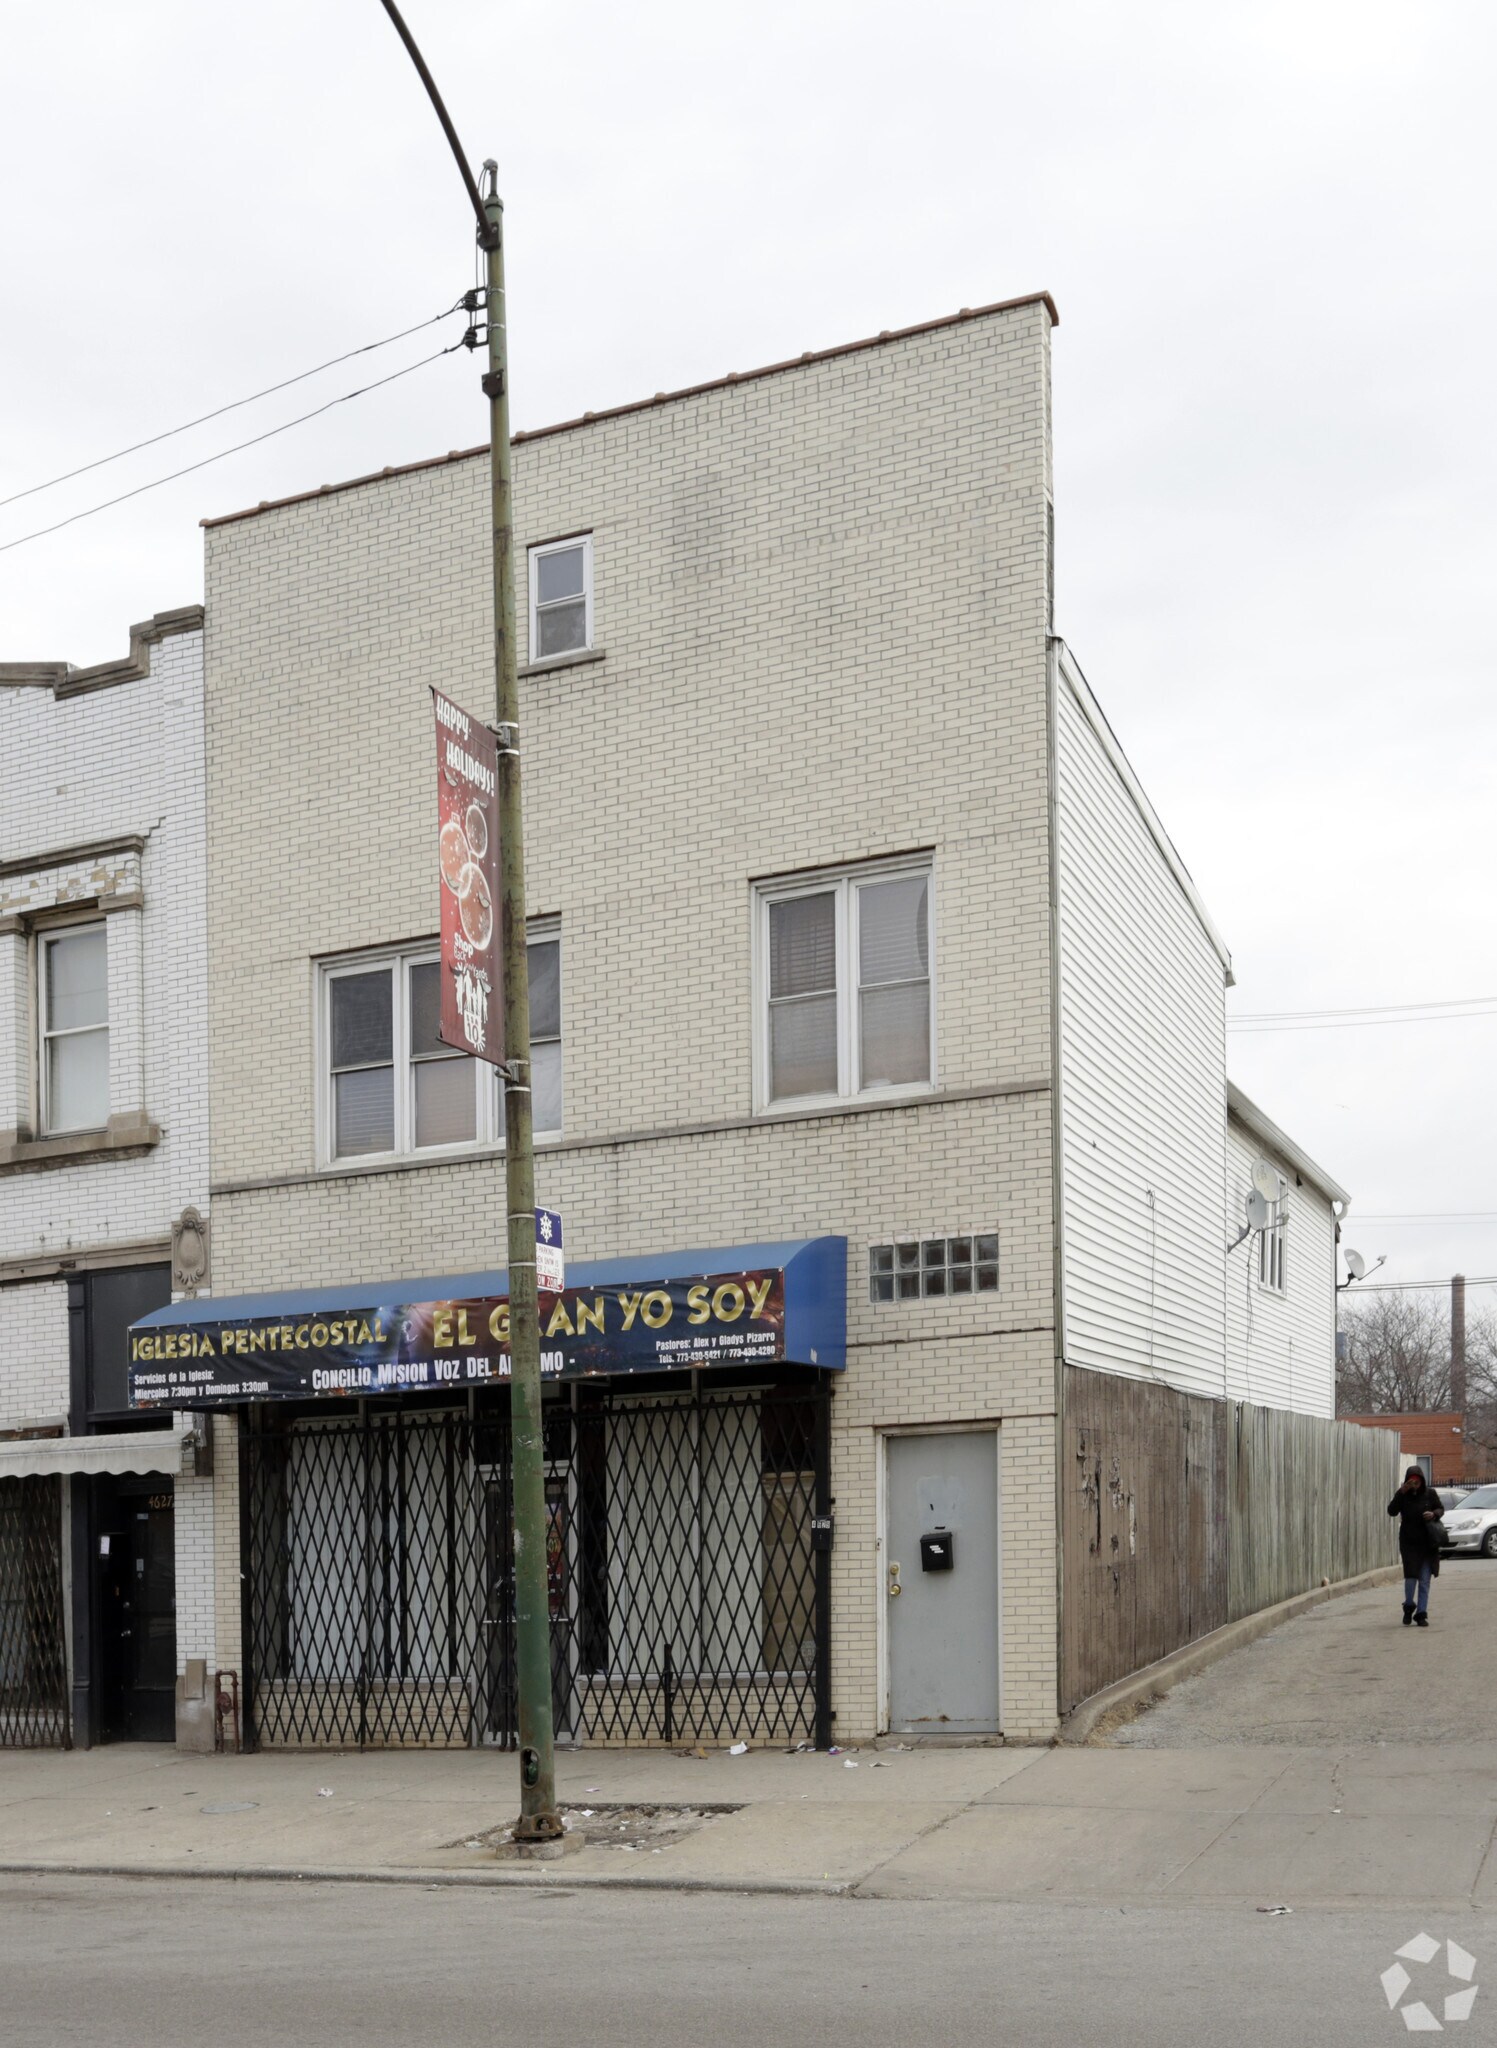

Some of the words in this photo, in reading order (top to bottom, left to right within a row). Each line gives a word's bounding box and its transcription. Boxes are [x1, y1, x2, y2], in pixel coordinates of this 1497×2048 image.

[436, 695, 469, 740] HAPPY
[446, 740, 495, 797] HOLIDAYS!
[454, 932, 474, 958] Shop
[466, 1022, 479, 1042] 10
[433, 1308, 476, 1348] EL
[489, 1296, 605, 1342] GAN
[617, 1290, 673, 1331] YO
[687, 1279, 772, 1324] SOY
[132, 1333, 215, 1361] IGLESIA
[221, 1318, 387, 1354] PENTECOSTAL
[655, 1340, 691, 1351] Pastores:
[693, 1336, 710, 1348] Alex
[711, 1337, 717, 1348] y
[719, 1334, 744, 1346] Gladys
[746, 1332, 776, 1343] Pizarro
[658, 1353, 675, 1364] Tels.
[134, 1373, 167, 1385] Servicios
[168, 1372, 178, 1383] de
[179, 1371, 187, 1382] la
[188, 1369, 214, 1382] Iglesia:
[312, 1366, 371, 1390] CONCILIO
[377, 1362, 428, 1385] MISION
[434, 1359, 461, 1381] VOZ
[467, 1356, 493, 1378] DEL
[134, 1387, 169, 1400] Miercoles
[171, 1386, 197, 1397] 7:30pm
[198, 1386, 203, 1397] y
[205, 1383, 240, 1395] Domingos
[241, 1381, 269, 1393] 3:30pm
[148, 1495, 173, 1509] 4627
